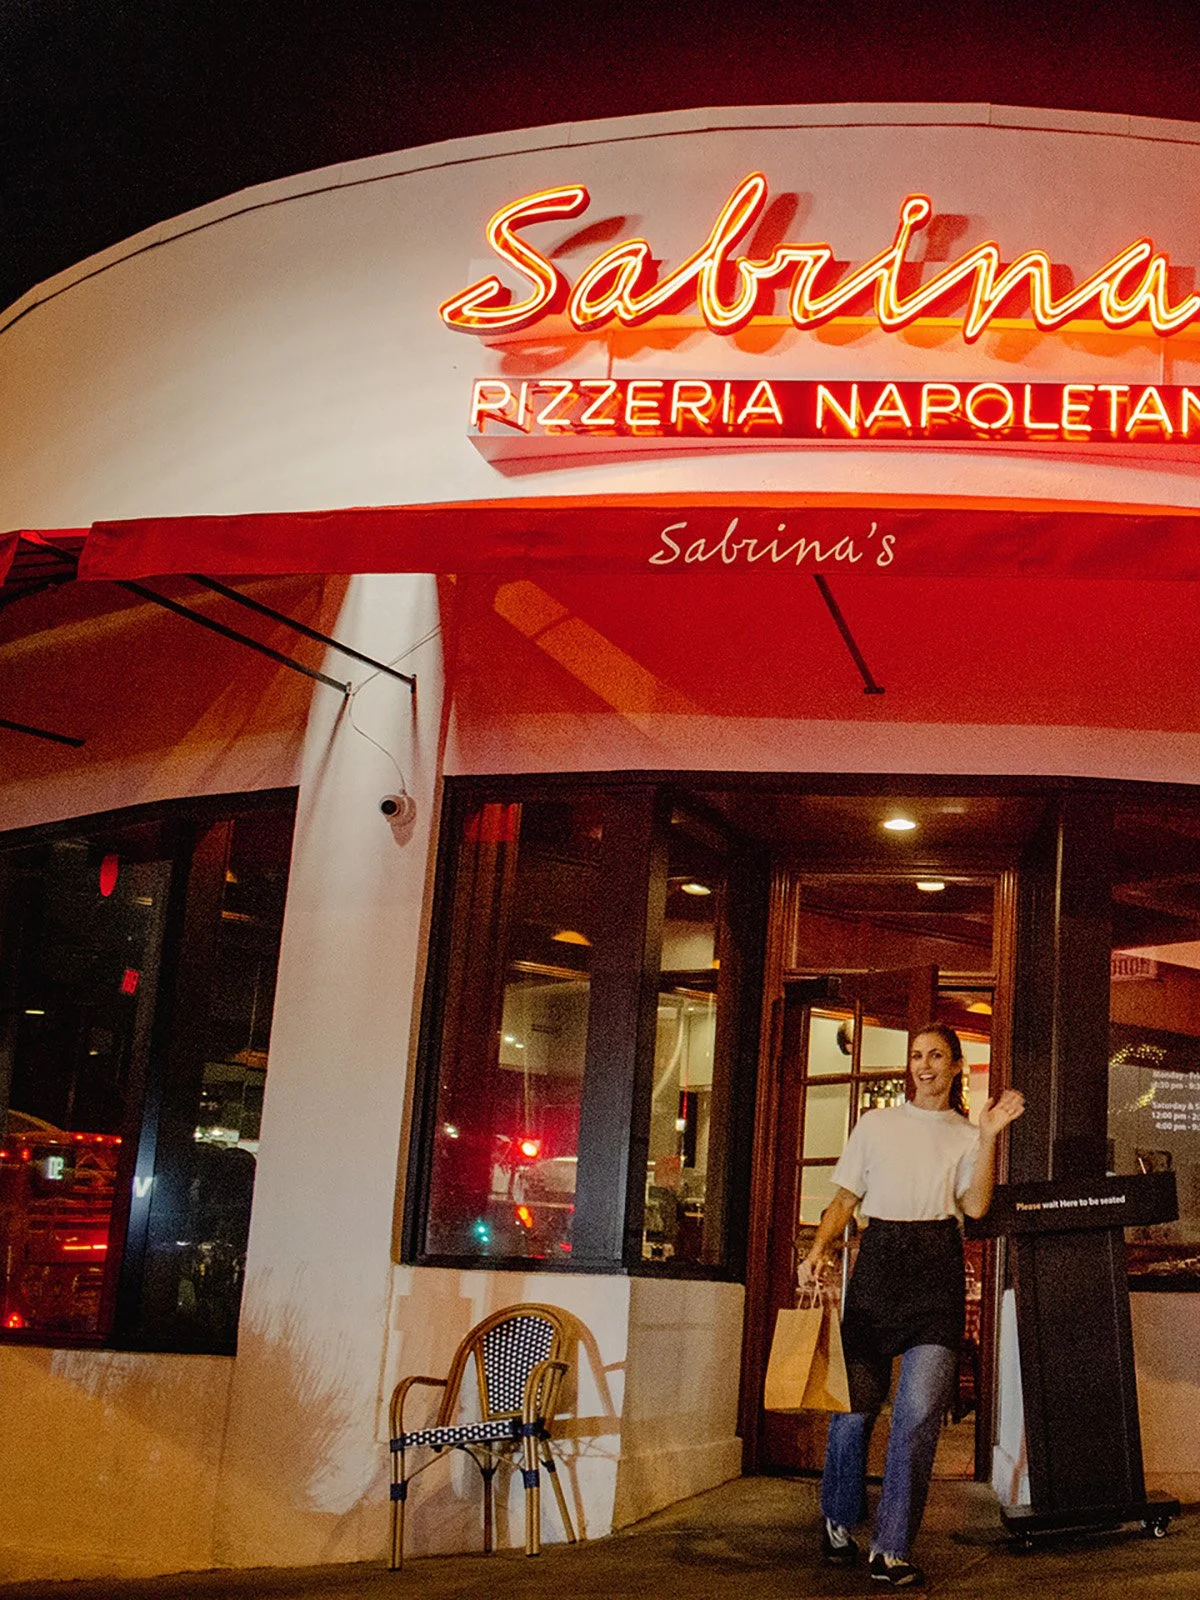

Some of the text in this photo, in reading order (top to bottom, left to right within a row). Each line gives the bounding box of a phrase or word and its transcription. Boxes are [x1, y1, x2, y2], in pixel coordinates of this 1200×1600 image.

[471, 379, 784, 428] PIZZERIA
[648, 517, 896, 567] Sabrina's
[1152, 1071, 1184, 1081] Monday
[1170, 1082, 1184, 1091] pm
[1151, 1101, 1187, 1111] Saturday
[1151, 1112, 1173, 1120] 12:00
[1173, 1113, 1187, 1122] pm
[1155, 1122, 1173, 1130] 4:00
[1173, 1123, 1187, 1132] pm
[1016, 1195, 1126, 1211] Please wait Here to be seated
